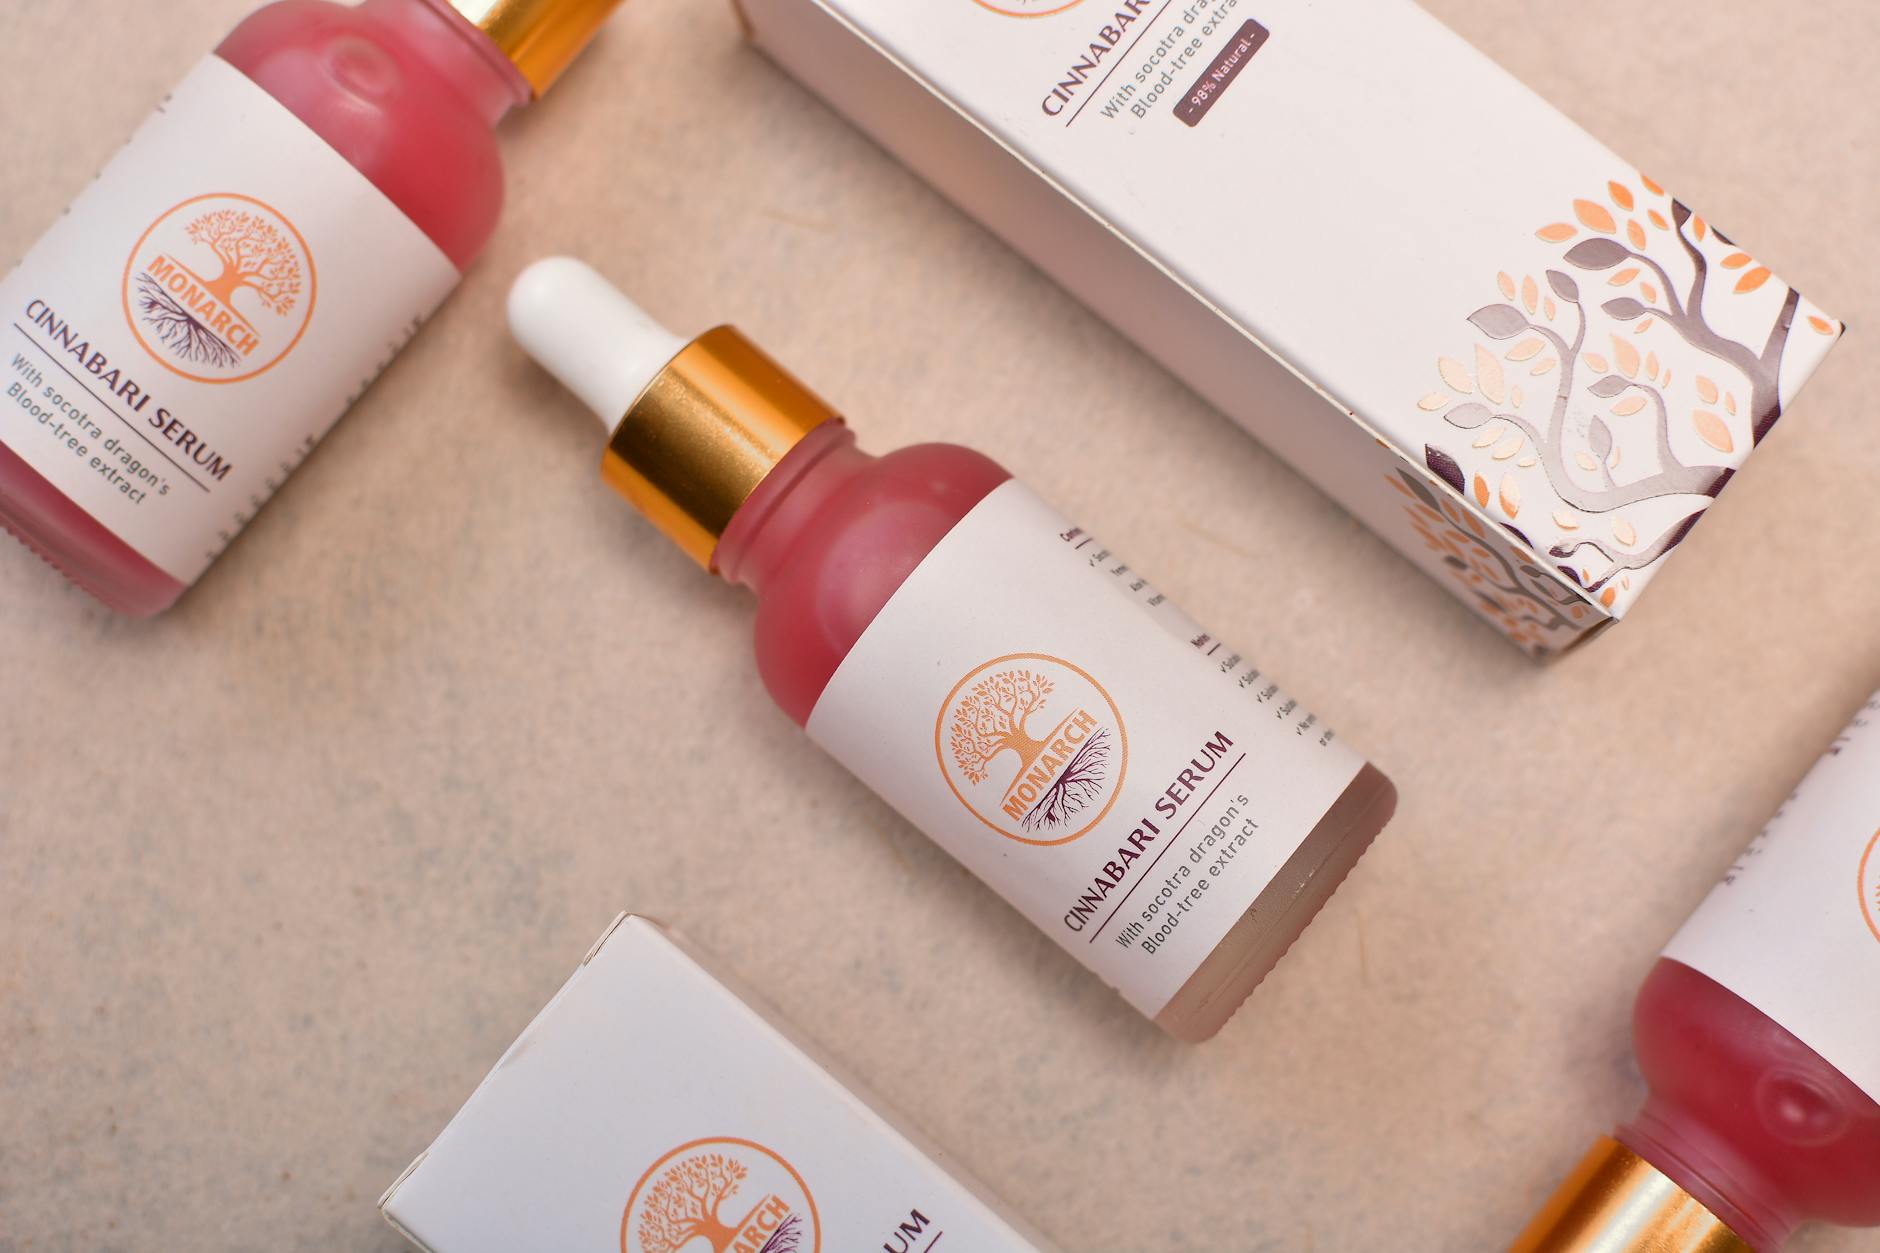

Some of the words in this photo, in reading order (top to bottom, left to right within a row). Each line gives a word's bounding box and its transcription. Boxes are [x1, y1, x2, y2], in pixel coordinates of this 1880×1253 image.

[1101, 82, 1137, 119] With
[1135, 26, 1184, 84] socotra
[1184, 0, 1214, 24] dra
[1130, 38, 1202, 120] Blood-tree
[1191, 82, 1216, 106] 98%
[1211, 38, 1251, 83] Natural
[146, 255, 259, 356] MONARCH
[7, 382, 88, 457] Blood-tree
[90, 456, 146, 504] extract
[10, 353, 43, 388] With
[43, 386, 102, 440] socotra
[104, 438, 170, 496] dragon's
[25, 299, 151, 412] CINNABARI
[148, 408, 232, 481] SERUM
[1002, 709, 1098, 822] MONARCH
[1064, 817, 1161, 932] CINNABARI
[1155, 731, 1234, 820] SERUM
[1115, 921, 1144, 949] With
[1142, 865, 1191, 922] socotra
[1190, 794, 1249, 864] dragon's
[1142, 879, 1210, 954] Blood-tree
[1209, 818, 1259, 877] extract
